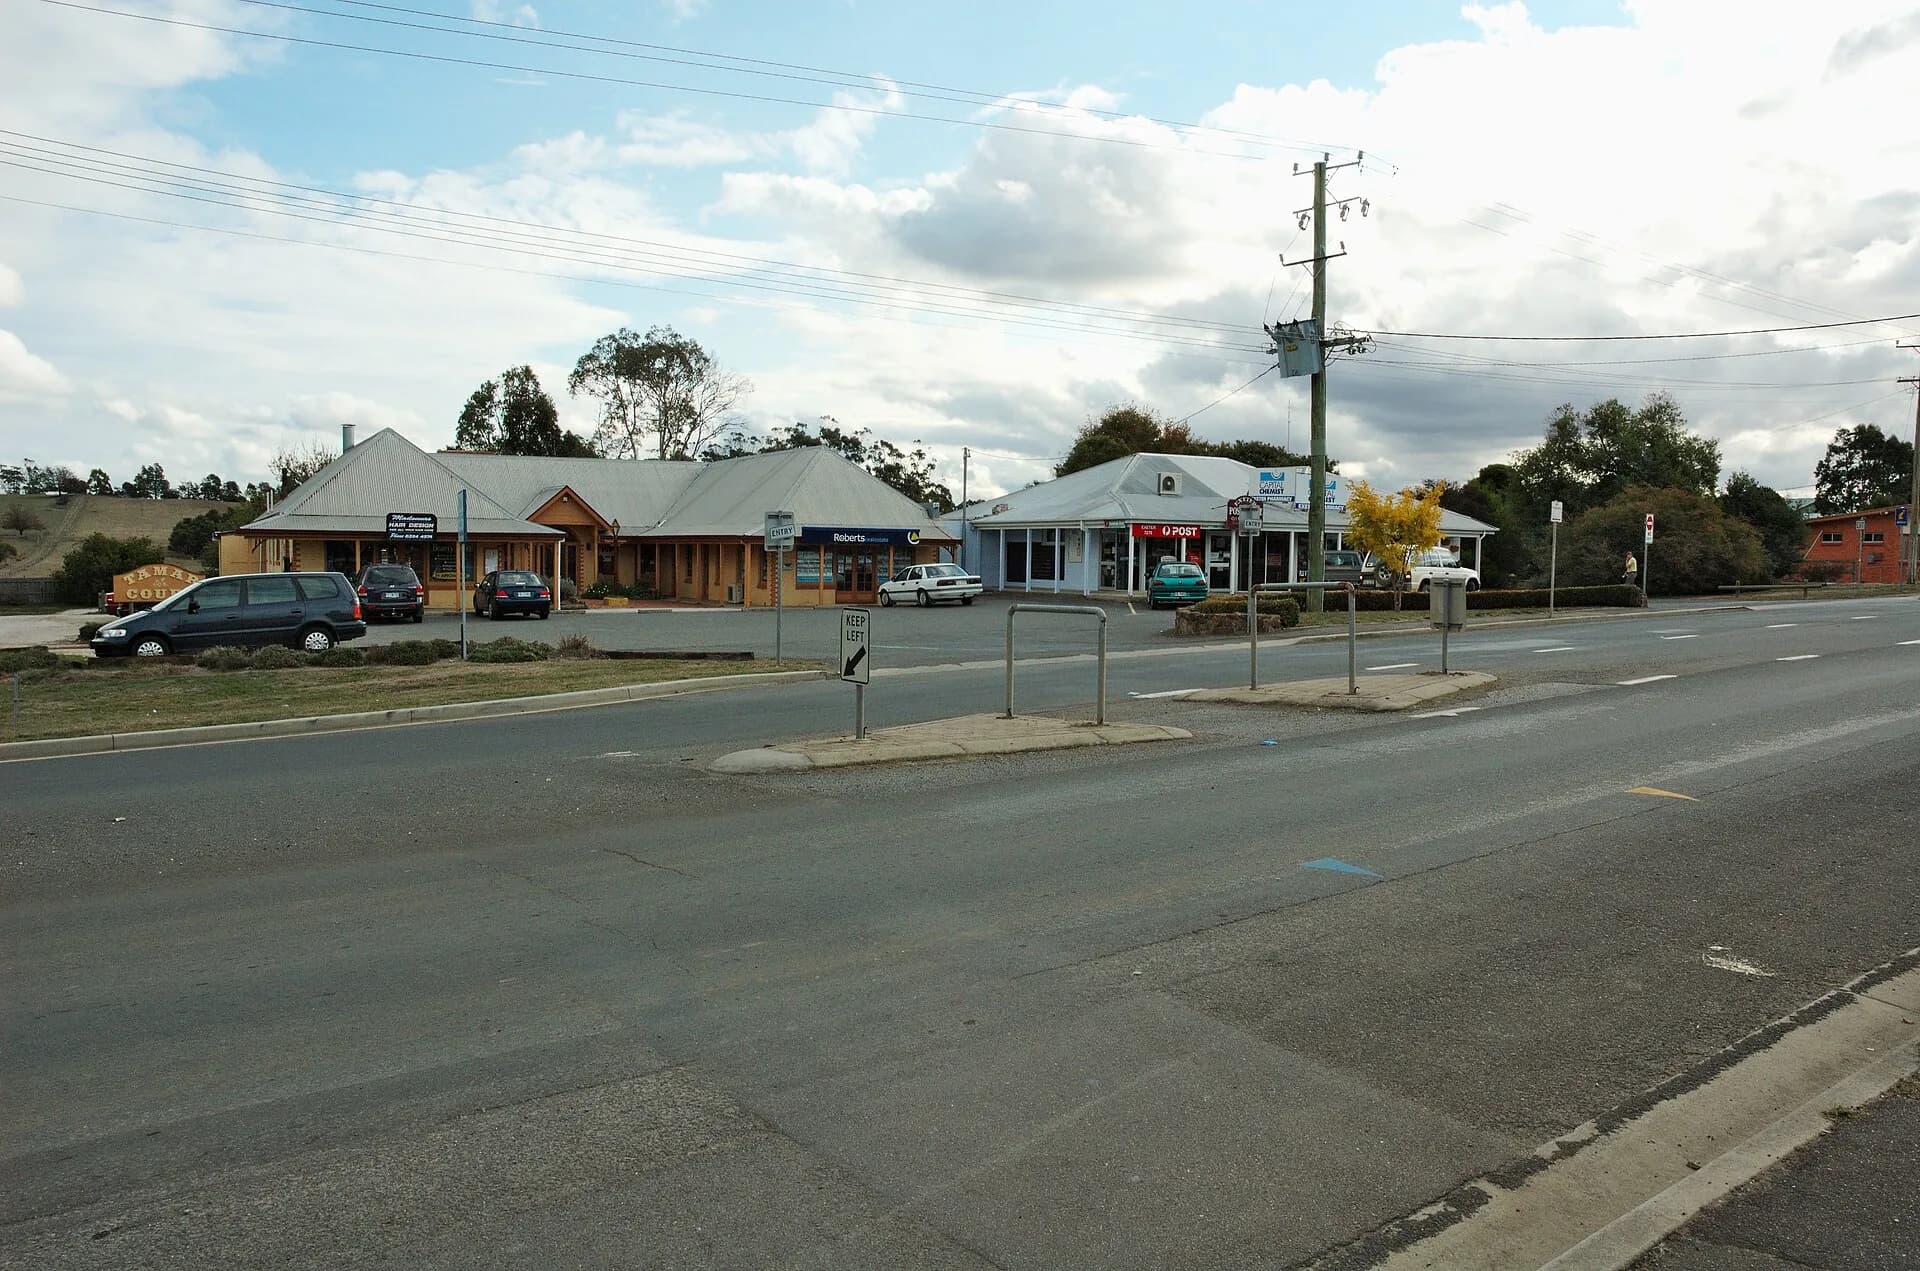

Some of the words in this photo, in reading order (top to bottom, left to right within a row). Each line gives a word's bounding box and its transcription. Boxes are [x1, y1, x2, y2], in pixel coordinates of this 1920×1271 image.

[771, 526, 793, 537] ENTRY
[1172, 526, 1198, 536] POST
[833, 533, 866, 542] Roberts
[846, 614, 866, 627] KEEP
[846, 629, 865, 643] LEFT
